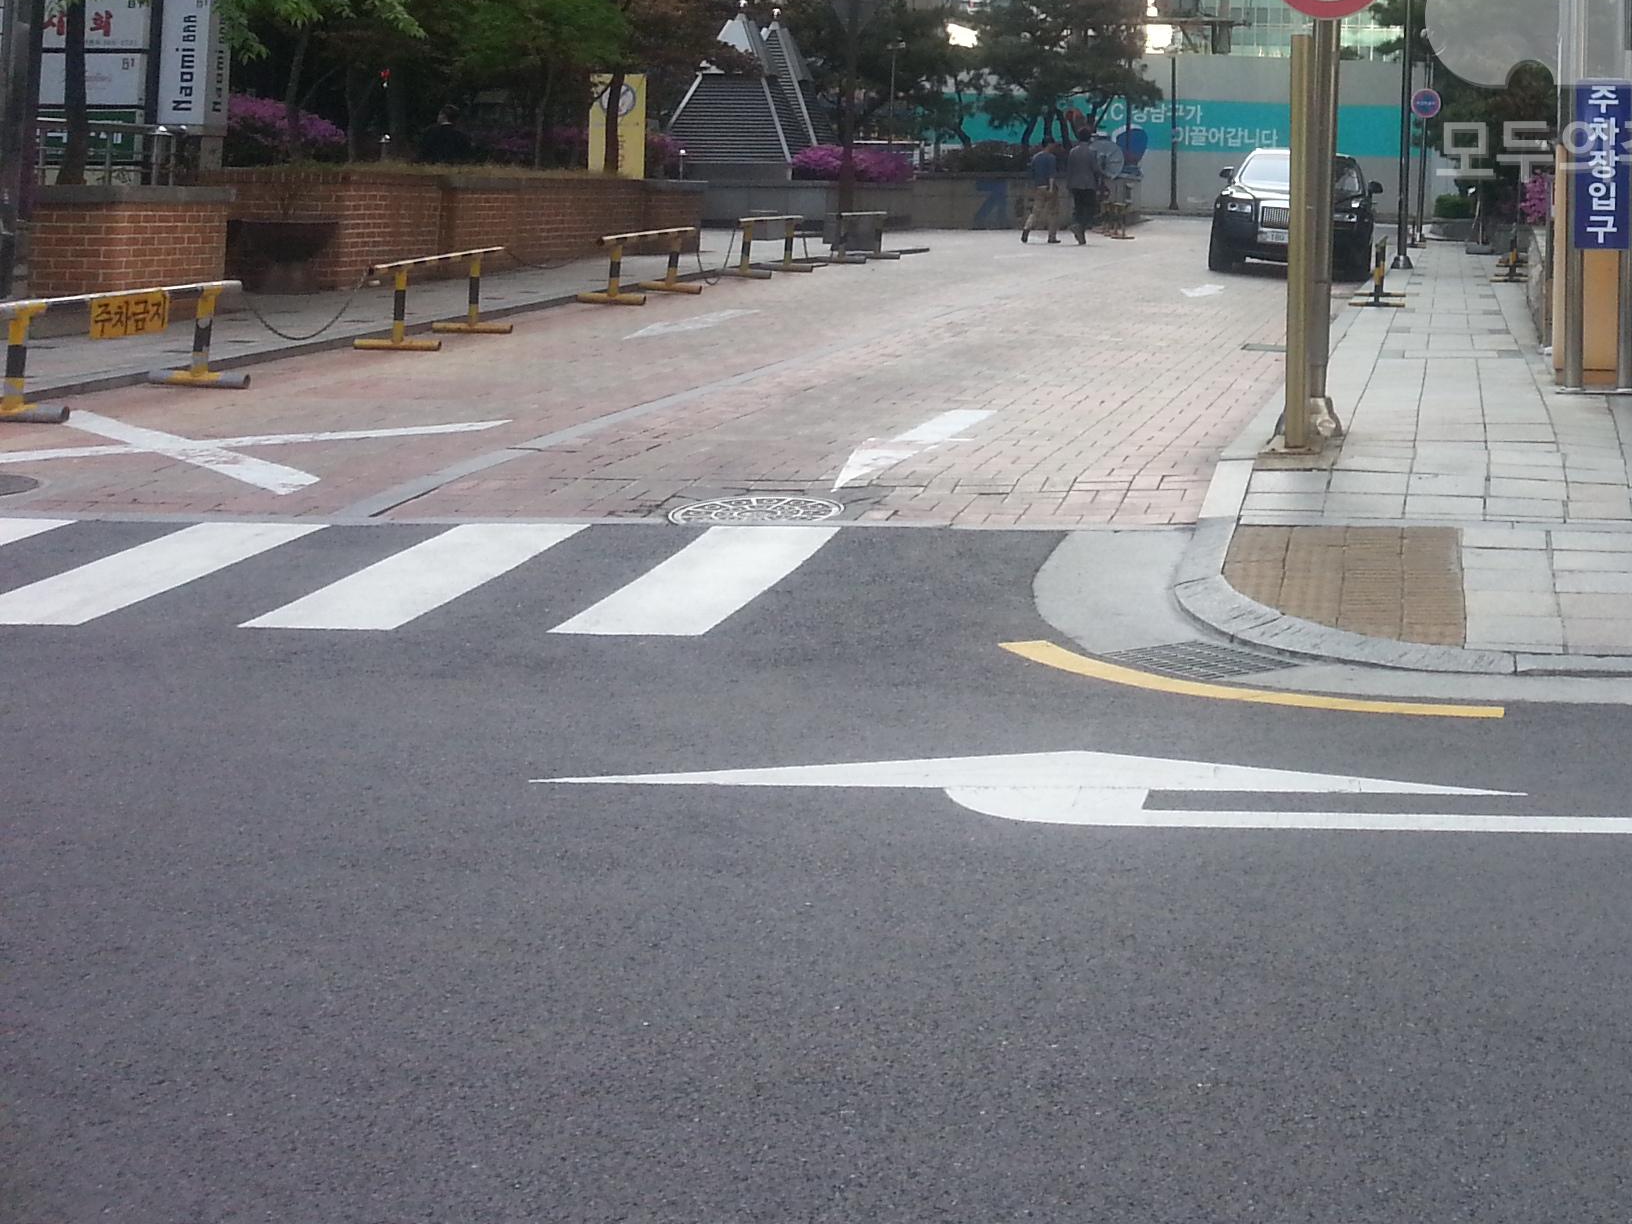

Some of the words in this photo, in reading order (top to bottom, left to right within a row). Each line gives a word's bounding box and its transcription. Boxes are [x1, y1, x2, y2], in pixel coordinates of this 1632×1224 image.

[182, 14, 198, 43] BAR
[172, 47, 196, 112] Naomi
[1174, 126, 1279, 147] 이끌어갑니다
[1586, 85, 1620, 244] 주차장입구
[94, 294, 167, 337] 주차금지
